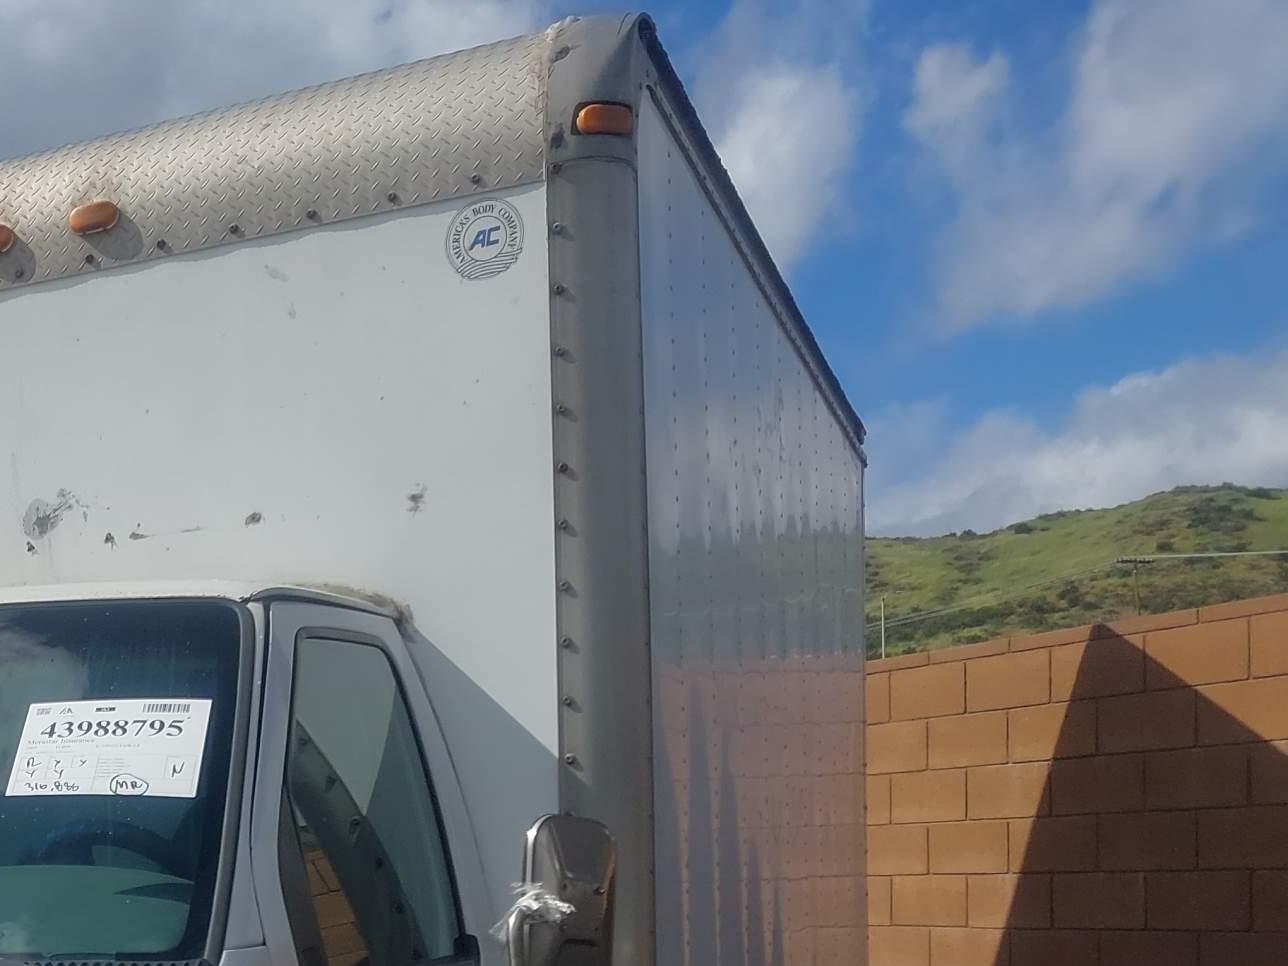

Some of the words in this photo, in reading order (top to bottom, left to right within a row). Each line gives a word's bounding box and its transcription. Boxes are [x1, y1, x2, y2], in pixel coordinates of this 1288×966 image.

[469, 225, 500, 250] AC
[472, 203, 496, 217] BODY
[498, 207, 518, 249] COMPANY
[40, 719, 184, 739] 43988795
